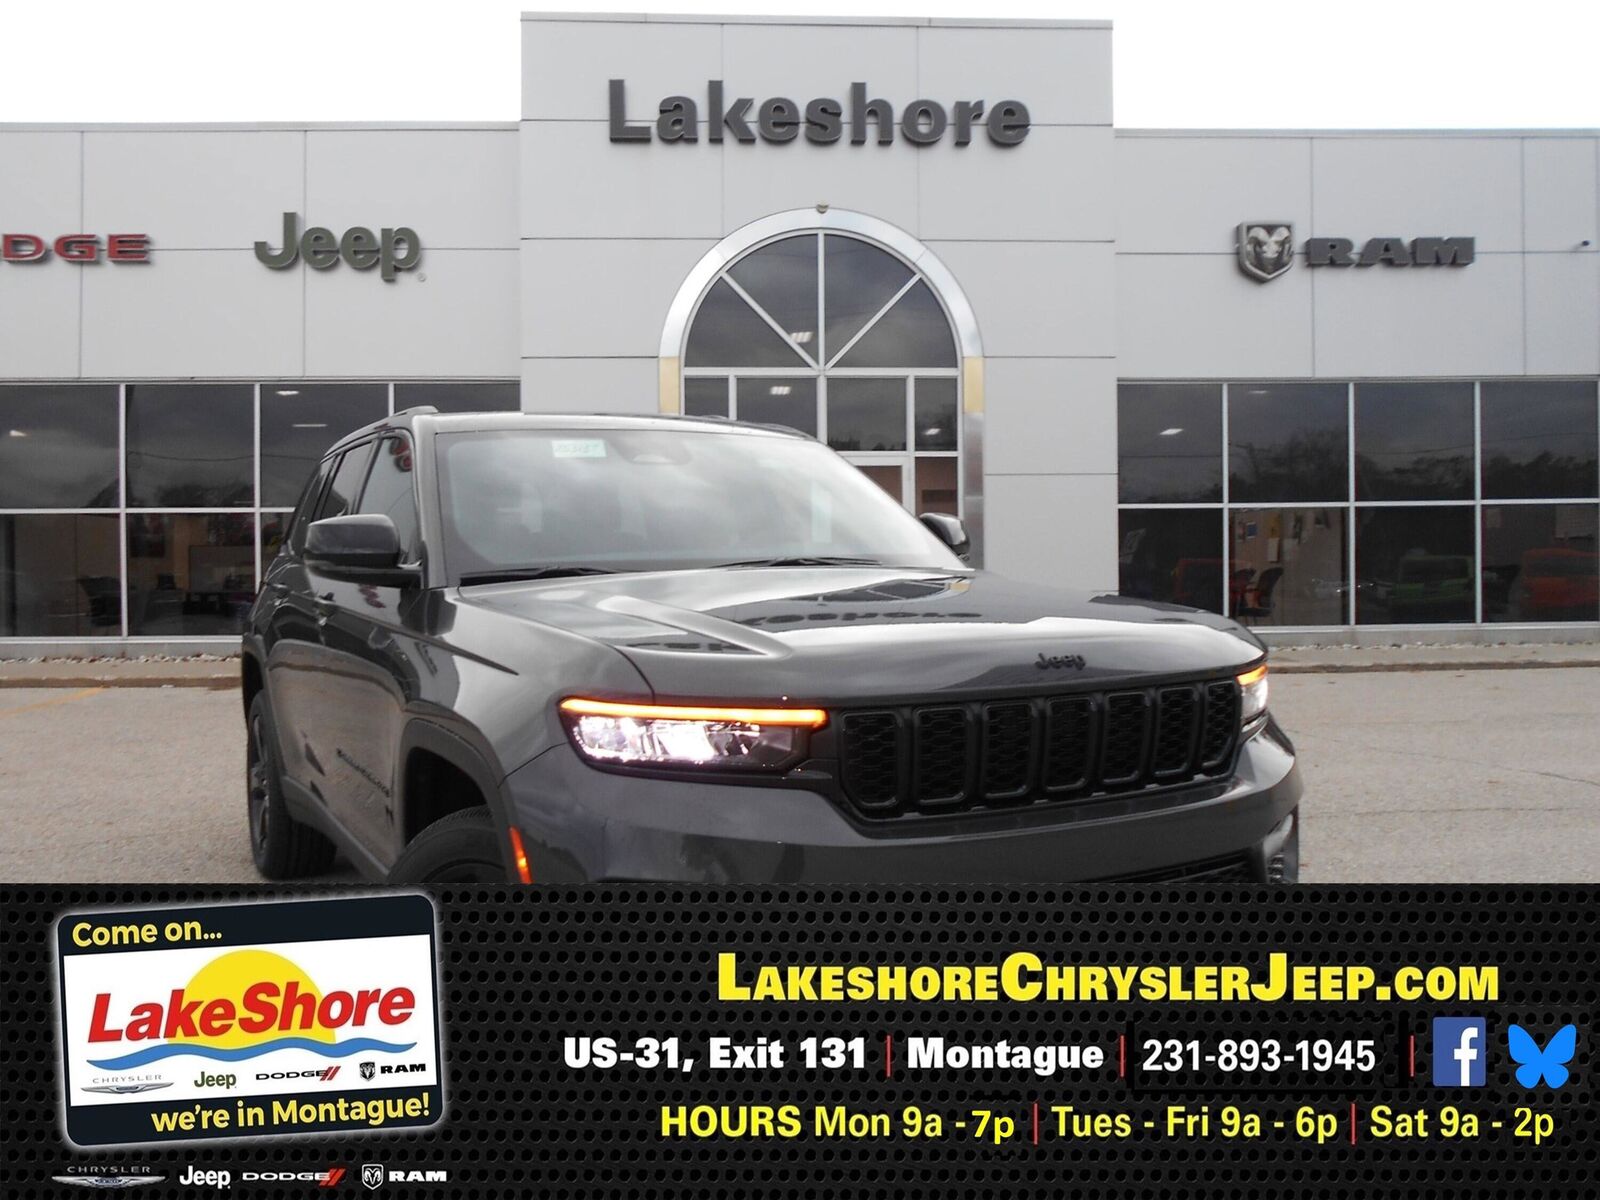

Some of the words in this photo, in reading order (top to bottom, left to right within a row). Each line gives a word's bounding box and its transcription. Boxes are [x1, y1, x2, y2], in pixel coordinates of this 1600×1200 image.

[609, 79, 1032, 145] Lakeshore
[1, 234, 150, 262] DGE
[254, 212, 421, 282] Jeep
[1305, 237, 1475, 266] RAM
[1035, 652, 1086, 671] Jeep
